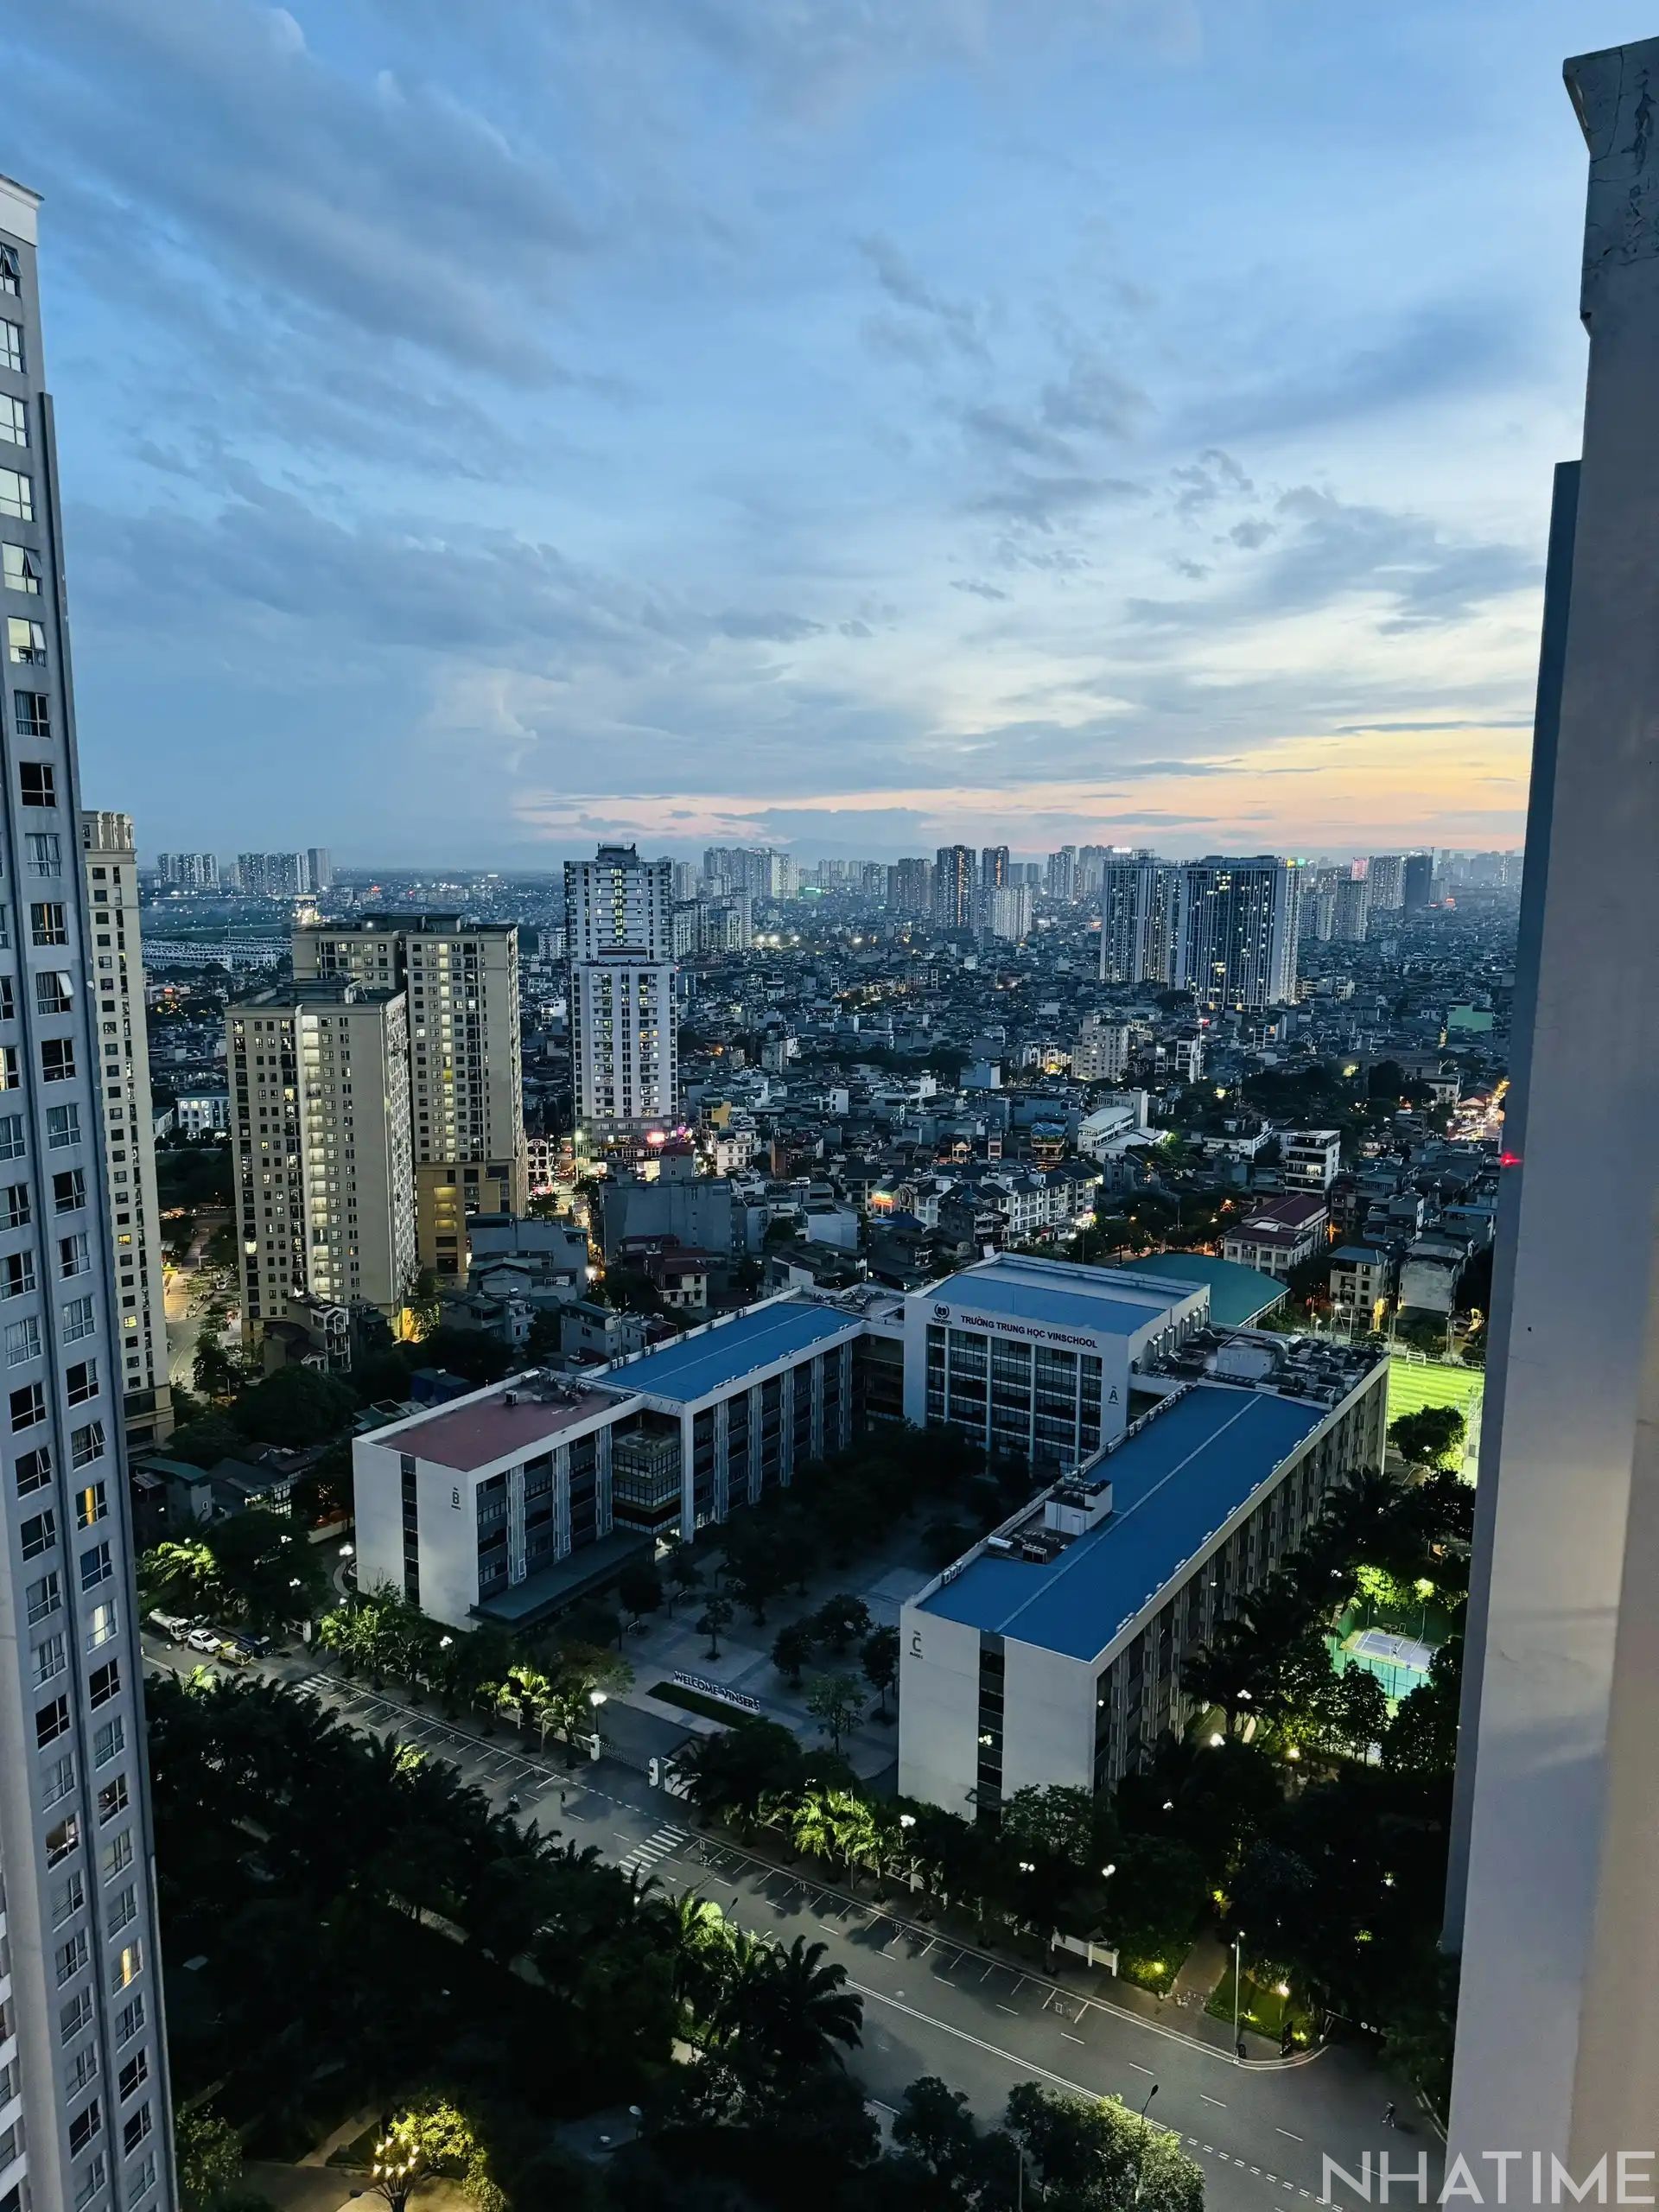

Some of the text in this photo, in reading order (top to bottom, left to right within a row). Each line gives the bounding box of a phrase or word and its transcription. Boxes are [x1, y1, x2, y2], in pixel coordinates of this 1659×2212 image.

[960, 1315, 995, 1329] TRƯỜNG
[996, 1321, 1026, 1334] TRUNG
[1027, 1328, 1046, 1338] HỌC
[1047, 1332, 1098, 1349] VINSCHOOL
[1109, 1389, 1118, 1402] A
[452, 1491, 460, 1504] B
[912, 1637, 922, 1652] C
[674, 1670, 760, 1711] WELCOME VINSERS
